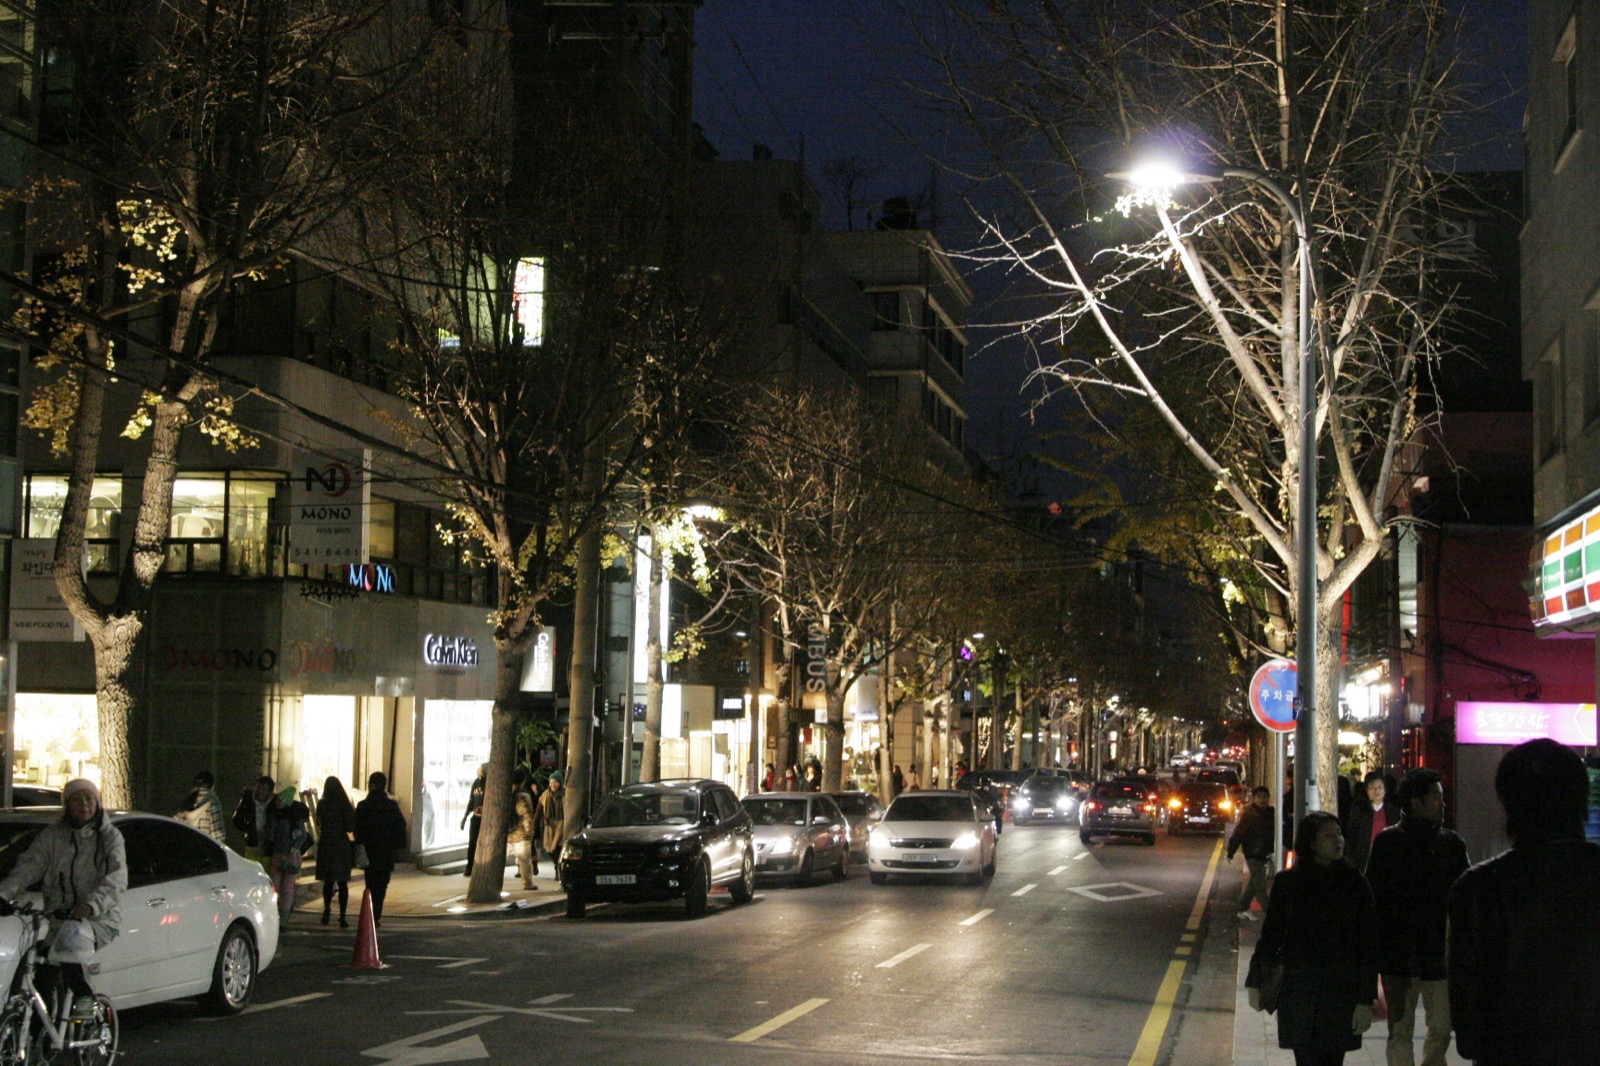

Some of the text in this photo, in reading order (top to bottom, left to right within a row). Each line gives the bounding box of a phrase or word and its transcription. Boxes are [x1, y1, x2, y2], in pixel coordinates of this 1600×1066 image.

[302, 507, 352, 521] MONO
[295, 548, 318, 556] 541
[349, 563, 397, 594] MONO
[56, 621, 70, 629] TEA
[424, 634, 479, 666] Calvin Klein
[806, 622, 827, 692] MBUS
[1260, 689, 1295, 702] 주차금
